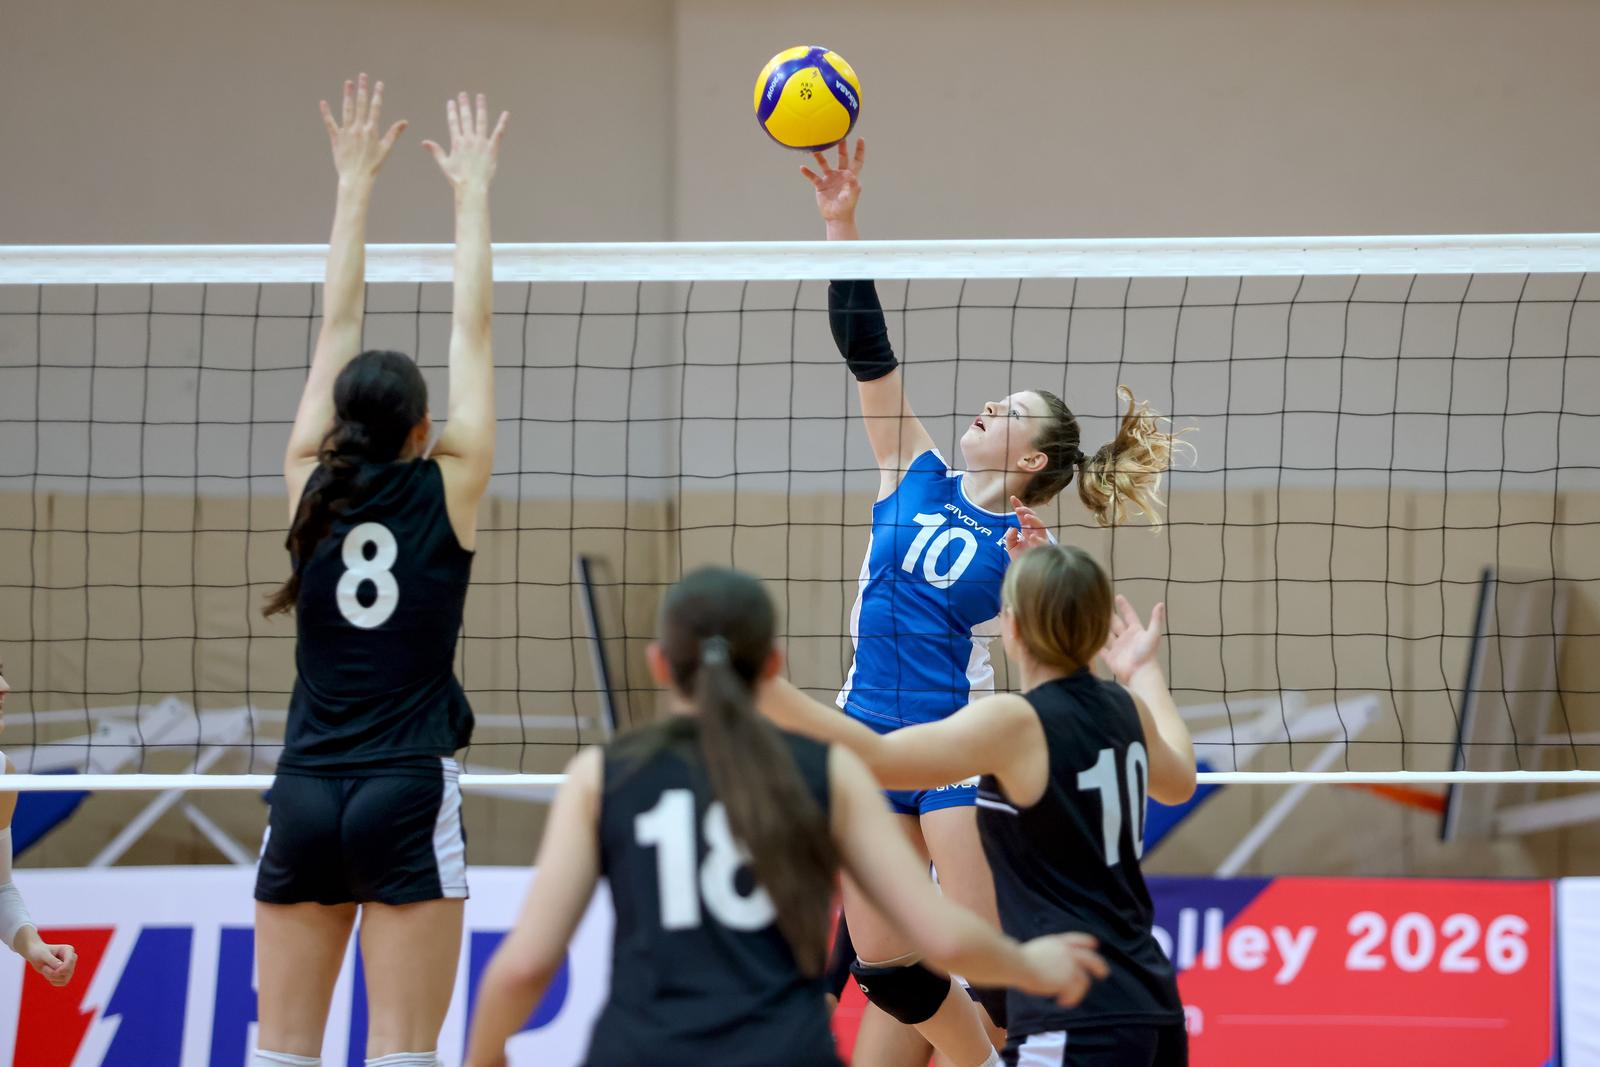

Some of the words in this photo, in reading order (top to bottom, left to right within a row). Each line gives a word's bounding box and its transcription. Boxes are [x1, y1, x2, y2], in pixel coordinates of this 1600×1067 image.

[901, 512, 958, 589] 10
[943, 503, 992, 537] GIVOVA
[335, 521, 400, 629] 8
[1077, 741, 1149, 867] 10
[1345, 911, 1530, 974] 2026
